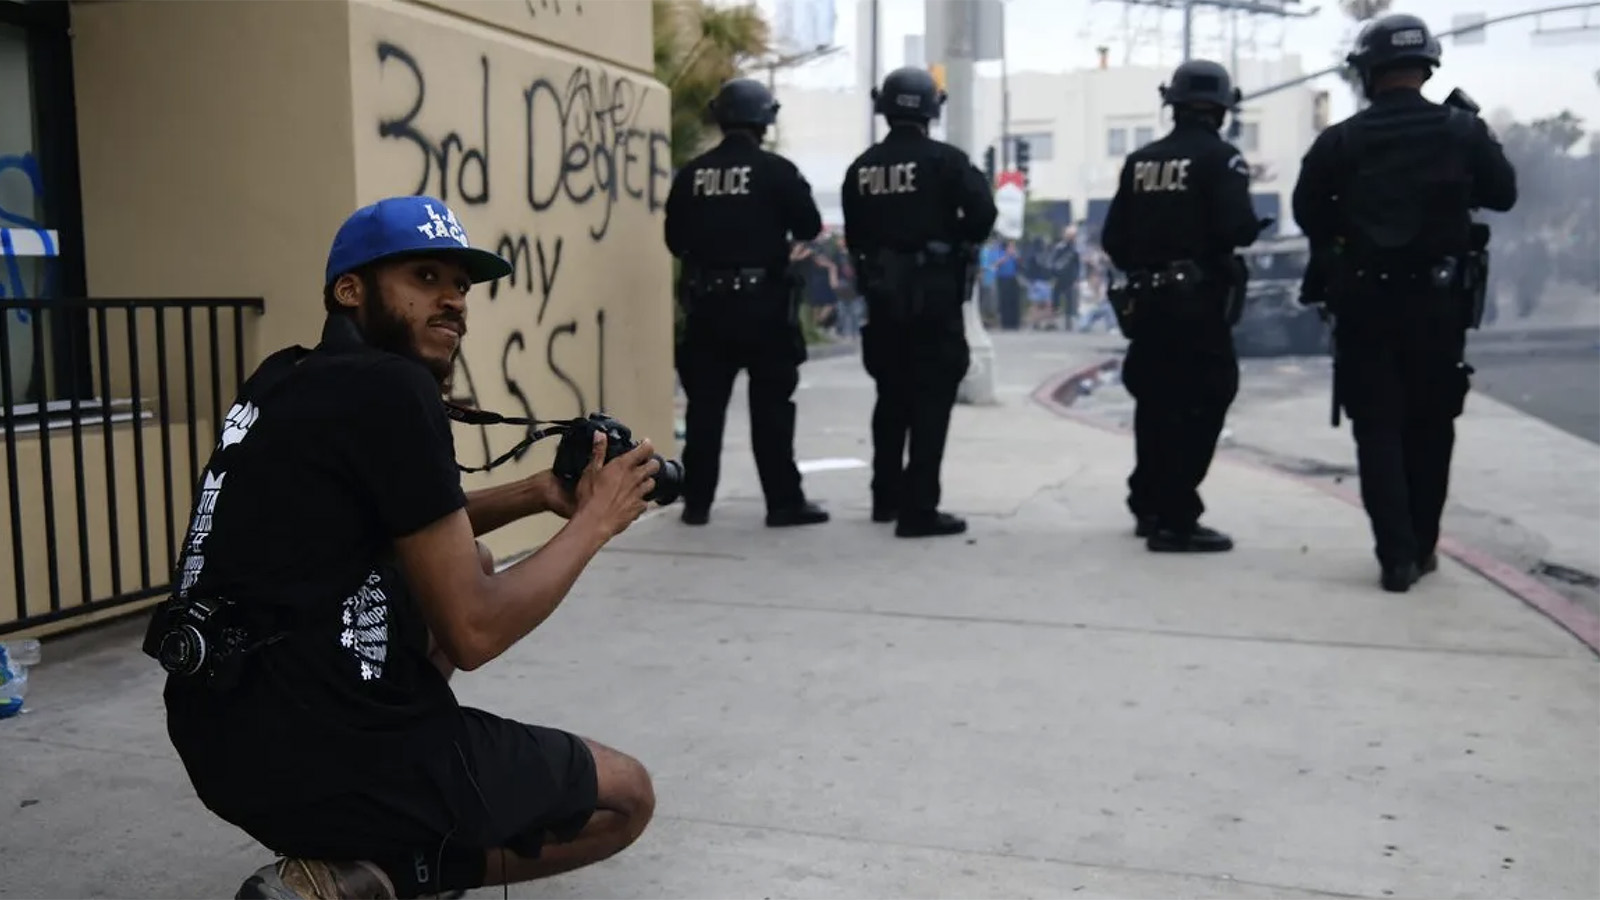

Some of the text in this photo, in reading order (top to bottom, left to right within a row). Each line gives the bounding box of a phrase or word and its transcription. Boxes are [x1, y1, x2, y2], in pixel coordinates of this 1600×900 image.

[377, 41, 490, 205] 3rd
[693, 165, 752, 196] POLICE
[858, 161, 917, 195] POLICE
[1133, 158, 1191, 193] POLICE
[416, 222, 469, 248] TACO
[488, 233, 563, 325] my
